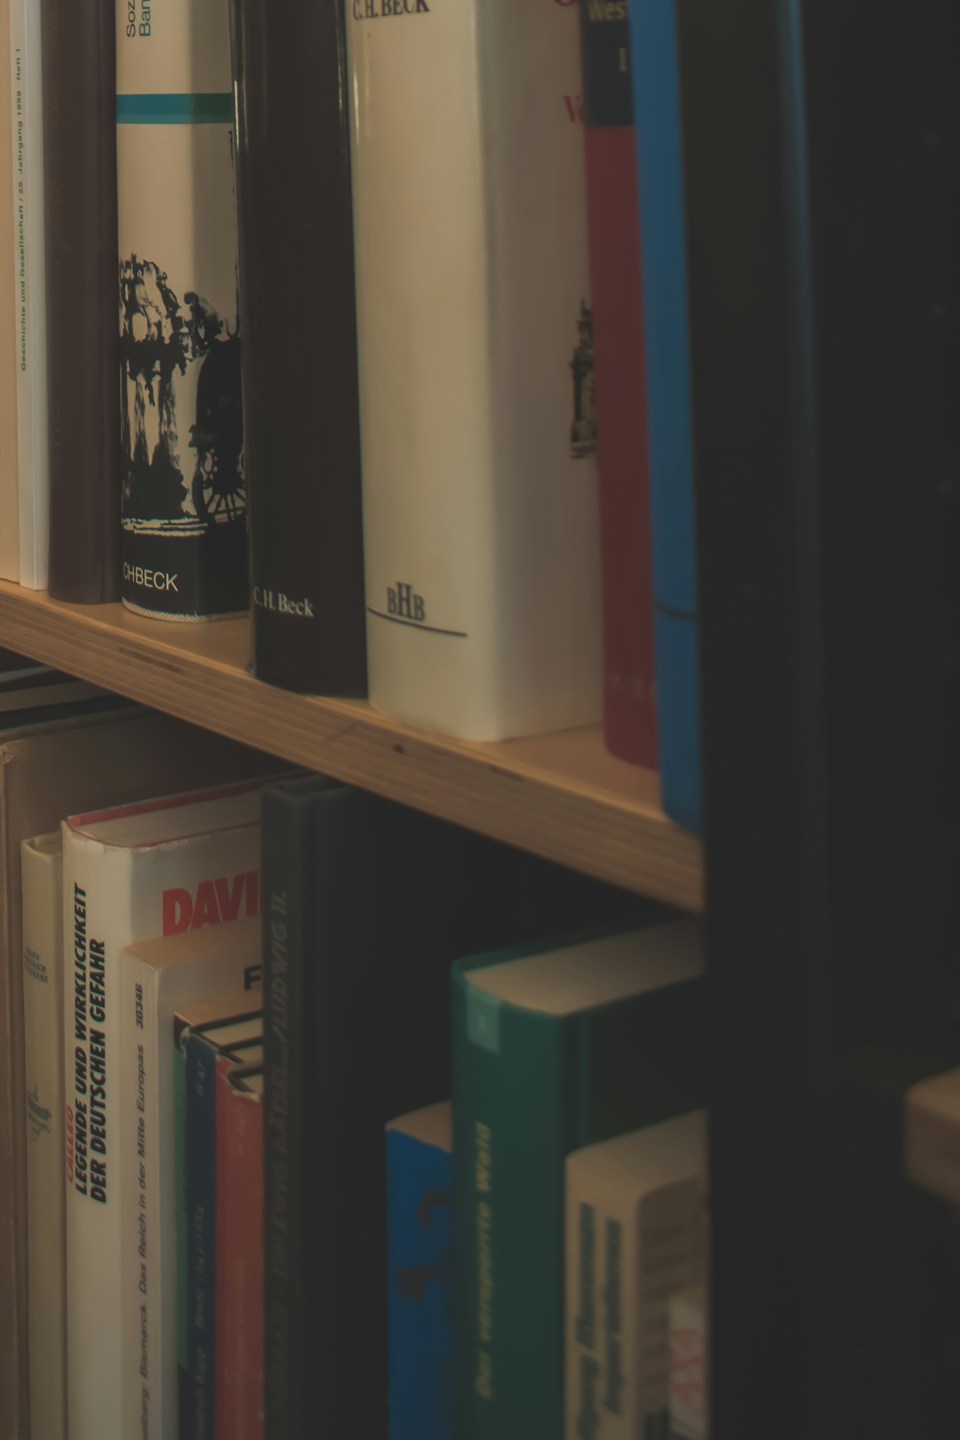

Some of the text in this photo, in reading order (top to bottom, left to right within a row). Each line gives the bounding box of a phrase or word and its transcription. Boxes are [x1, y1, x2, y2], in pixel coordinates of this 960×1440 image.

[16, 120, 24, 175] Jahrgang
[18, 205, 26, 278] Gesellschaft
[122, 560, 179, 593] CHBECK
[385, 581, 427, 622] BHB
[162, 868, 262, 937] DAVI
[135, 983, 144, 1030] 30346
[74, 882, 87, 1196] LEGENDE UND WIRKLICHKEIT
[89, 938, 106, 1204] DER DEUTSCHEN GEFAHR
[136, 1044, 146, 1113] Europas
[137, 1117, 145, 1158] Mitte
[137, 1161, 146, 1190] der
[138, 1194, 146, 1210] in
[137, 1213, 146, 1259] Reich
[138, 1263, 147, 1296] Das
